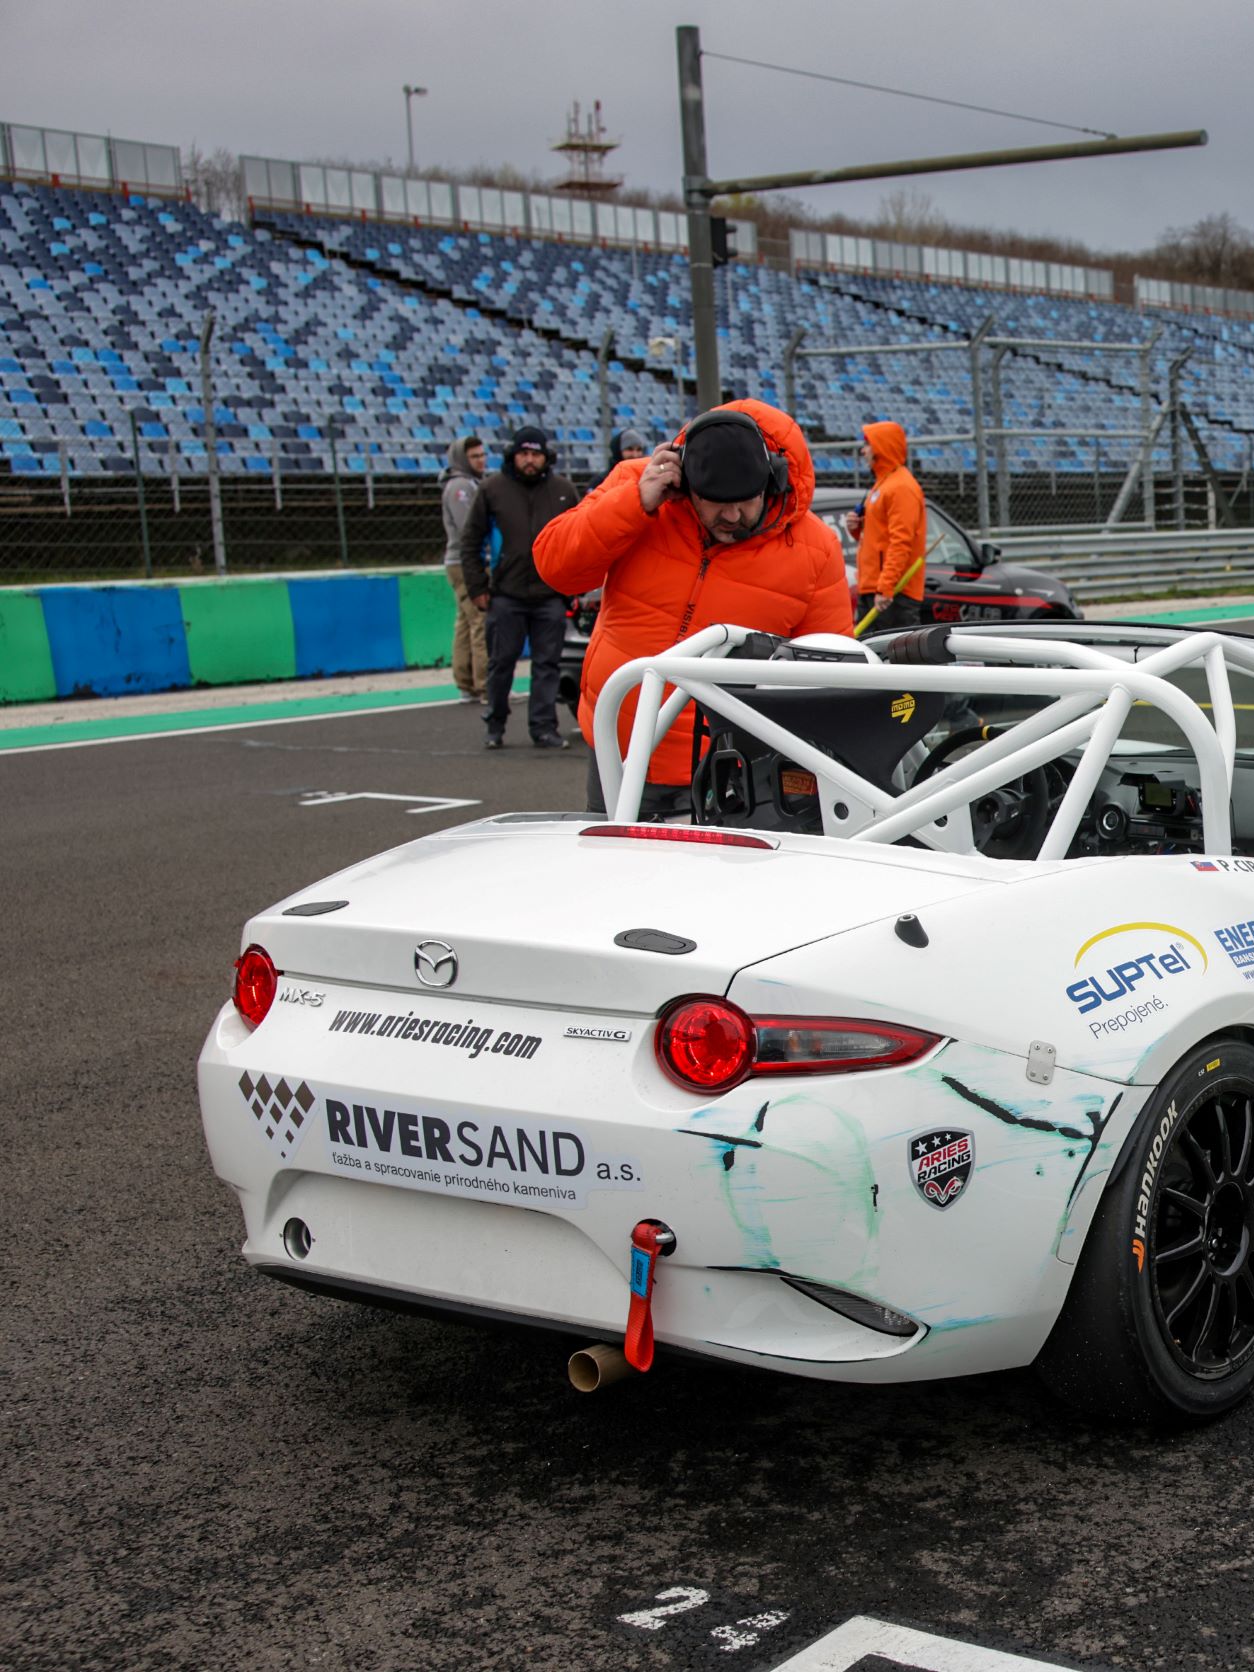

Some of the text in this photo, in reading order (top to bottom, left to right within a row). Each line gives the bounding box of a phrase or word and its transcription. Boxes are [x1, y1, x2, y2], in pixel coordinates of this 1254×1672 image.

[279, 987, 326, 1007] MX-5
[1089, 995, 1168, 1039] Prepojené.
[328, 1010, 543, 1060] www.ariesracing.com
[326, 1098, 642, 1182] RIVERSAND a.s.
[918, 1139, 968, 1172] ARIES
[332, 1151, 576, 1200] ťažba a spracovanie prirodného kameniva
[917, 1150, 971, 1182] RACING
